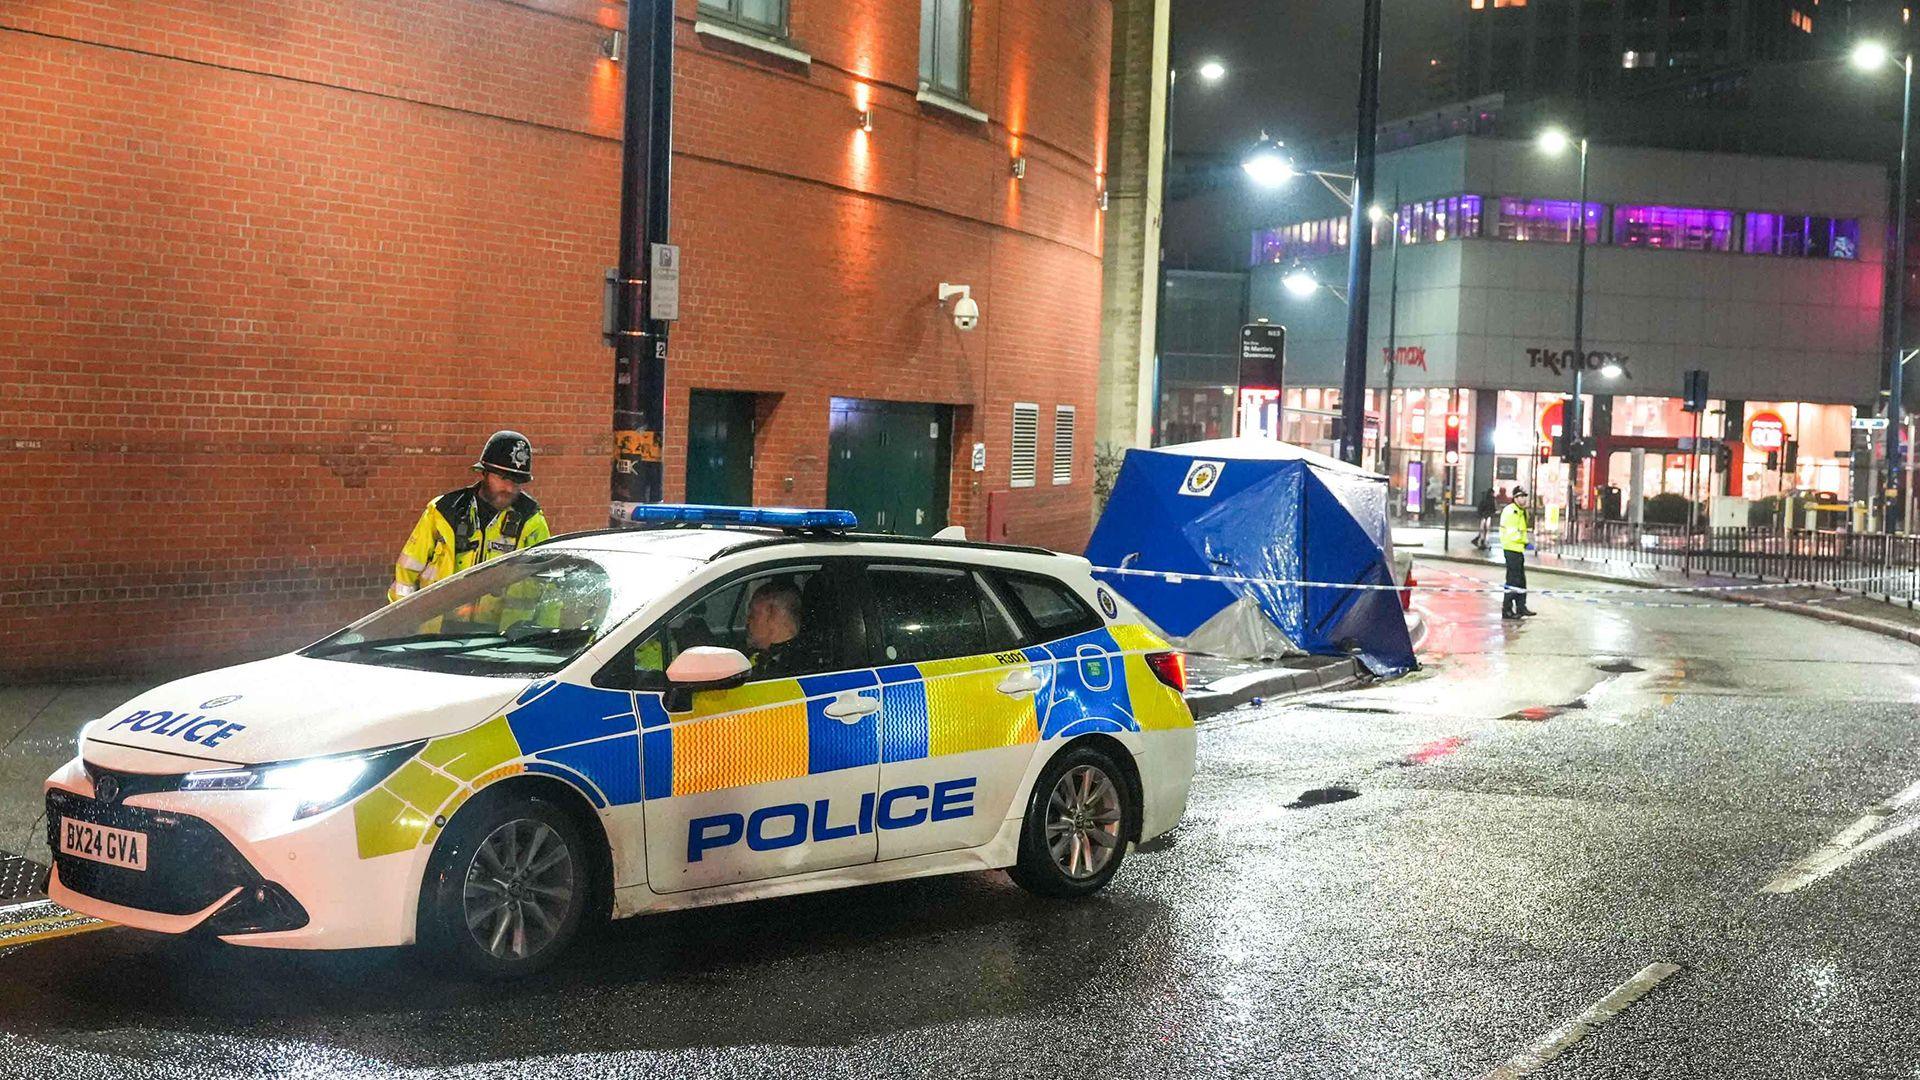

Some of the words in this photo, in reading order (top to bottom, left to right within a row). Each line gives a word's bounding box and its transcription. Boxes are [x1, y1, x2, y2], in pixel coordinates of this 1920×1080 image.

[995, 652, 1027, 665] R301
[107, 710, 247, 748] POLICE
[687, 777, 977, 863] POLICE
[66, 822, 103, 857] BX24
[106, 832, 139, 865] GVA
